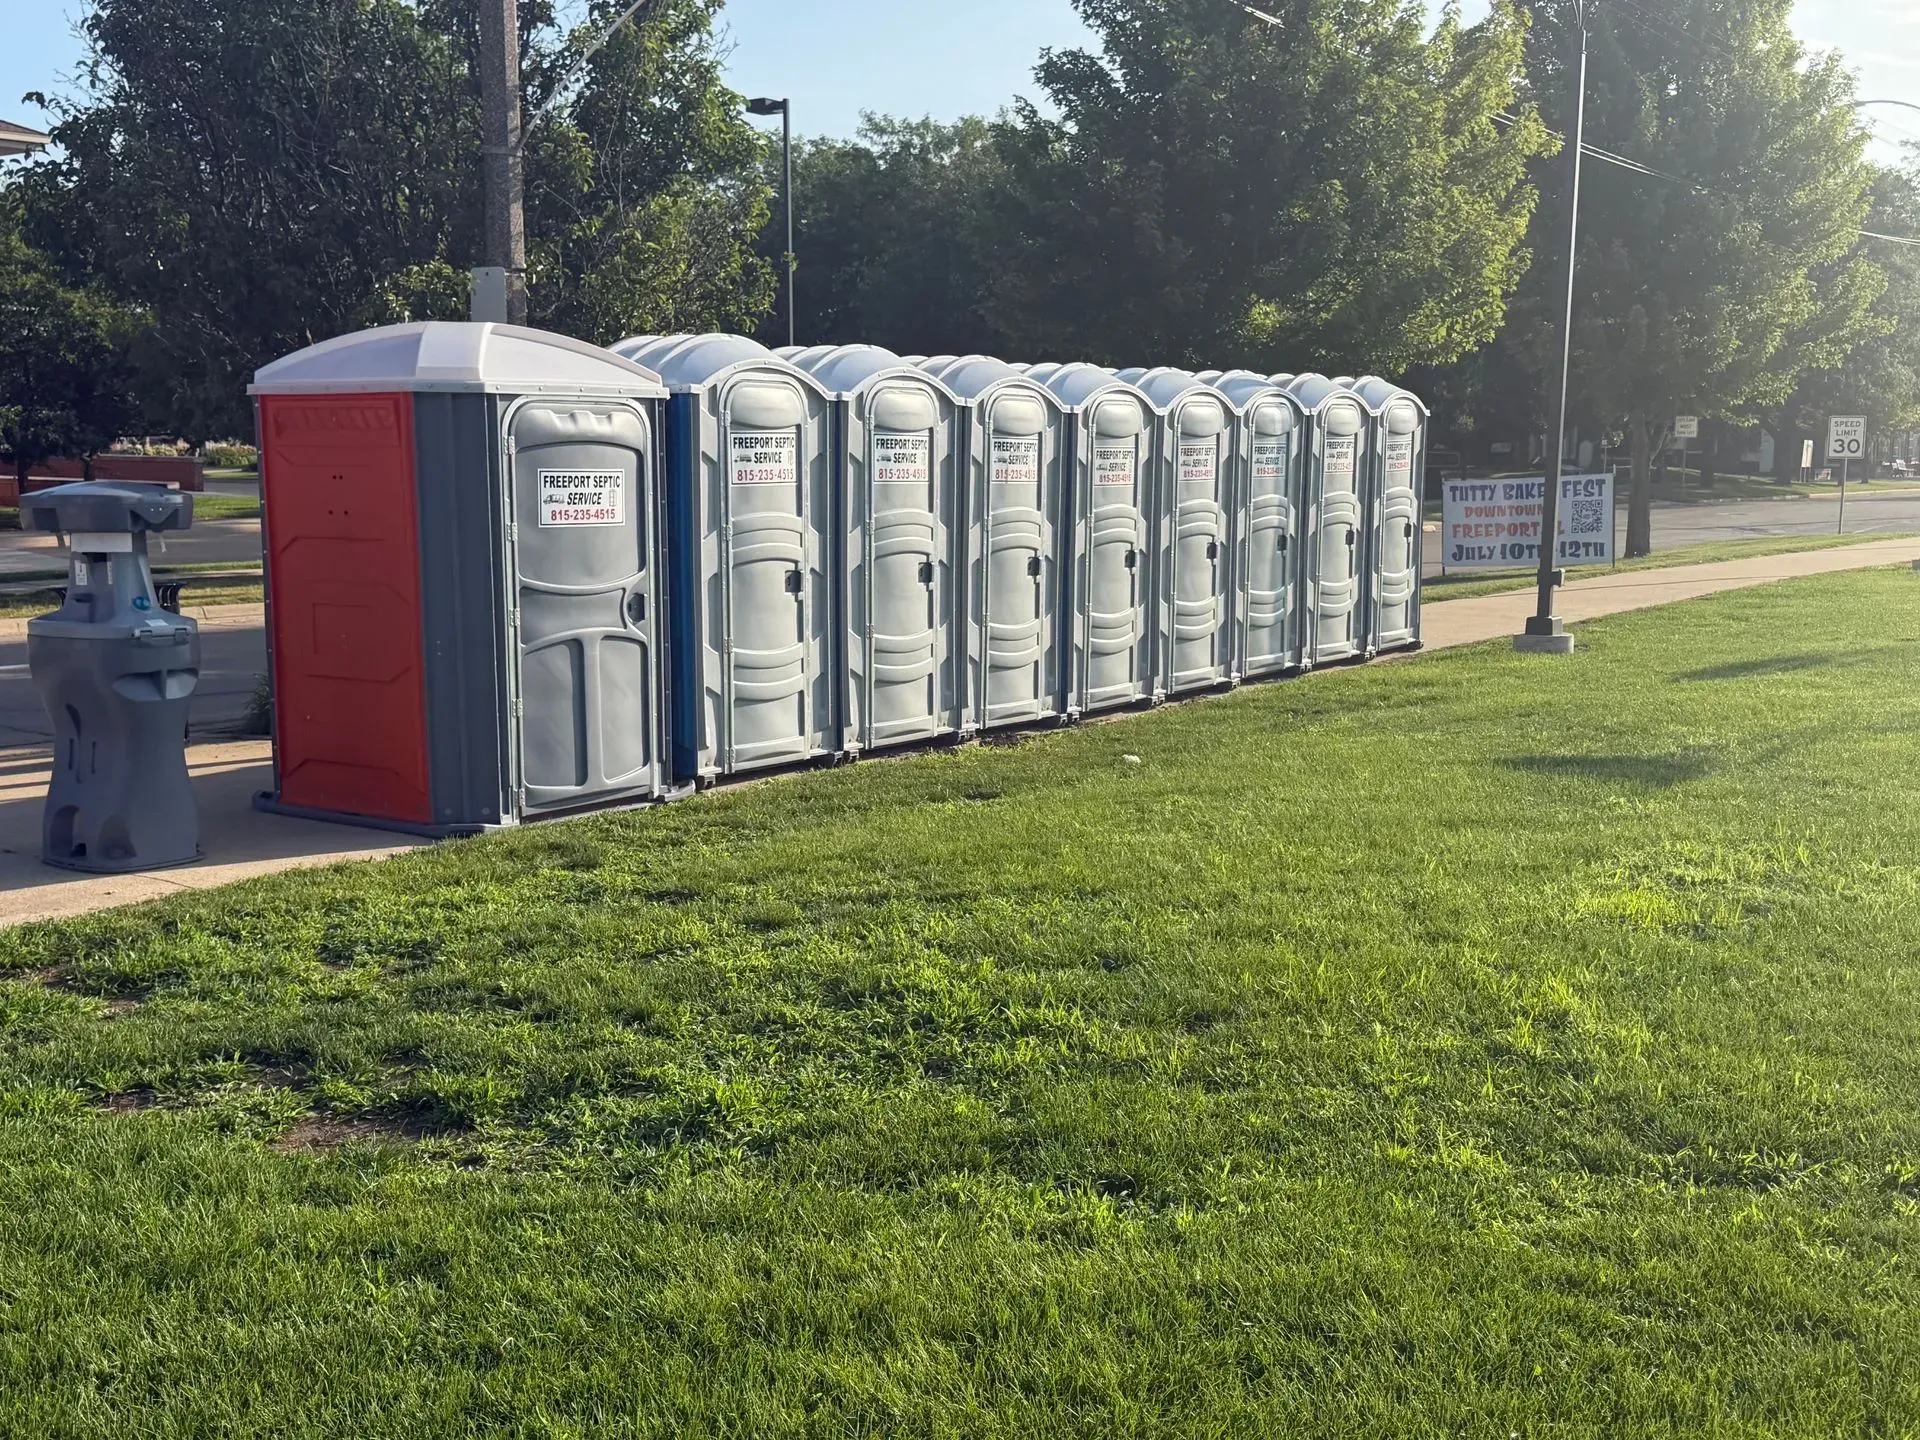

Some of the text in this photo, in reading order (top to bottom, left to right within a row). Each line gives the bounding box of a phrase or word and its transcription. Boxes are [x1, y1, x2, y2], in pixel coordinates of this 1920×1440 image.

[1834, 420, 1861, 428] SPEED
[733, 436, 795, 449] FREEPORT SEPTIC
[876, 438, 928, 450] FREEPORT SEPTIC
[993, 441, 1023, 452] FREEPORT
[1326, 441, 1345, 449] FREEPORT
[1833, 438, 1860, 453] 30
[1096, 450, 1121, 460] FREEPORT
[1181, 447, 1204, 456] FREEPORT
[1254, 446, 1275, 455] FREEPORT
[753, 452, 782, 464] SERVICE
[893, 452, 917, 464] SERVICE
[1008, 454, 1029, 465] SERVICE
[1192, 458, 1209, 467] SERVICE
[1108, 462, 1127, 472] SERVICE
[737, 469, 794, 482] 815-235-4515
[878, 468, 927, 480] 815-235-4515
[995, 469, 1036, 480] 815-235-4515
[543, 475, 620, 488] FREEPORT SEPTIC
[1450, 479, 1606, 502] TUTTY BAKE FEST
[567, 492, 602, 505] SERVICE
[551, 508, 616, 521] 815-235-4515
[1464, 504, 1543, 518] DOWNTOWN
[1452, 522, 1540, 539] FREEPORT
[1452, 544, 1496, 561] JULY
